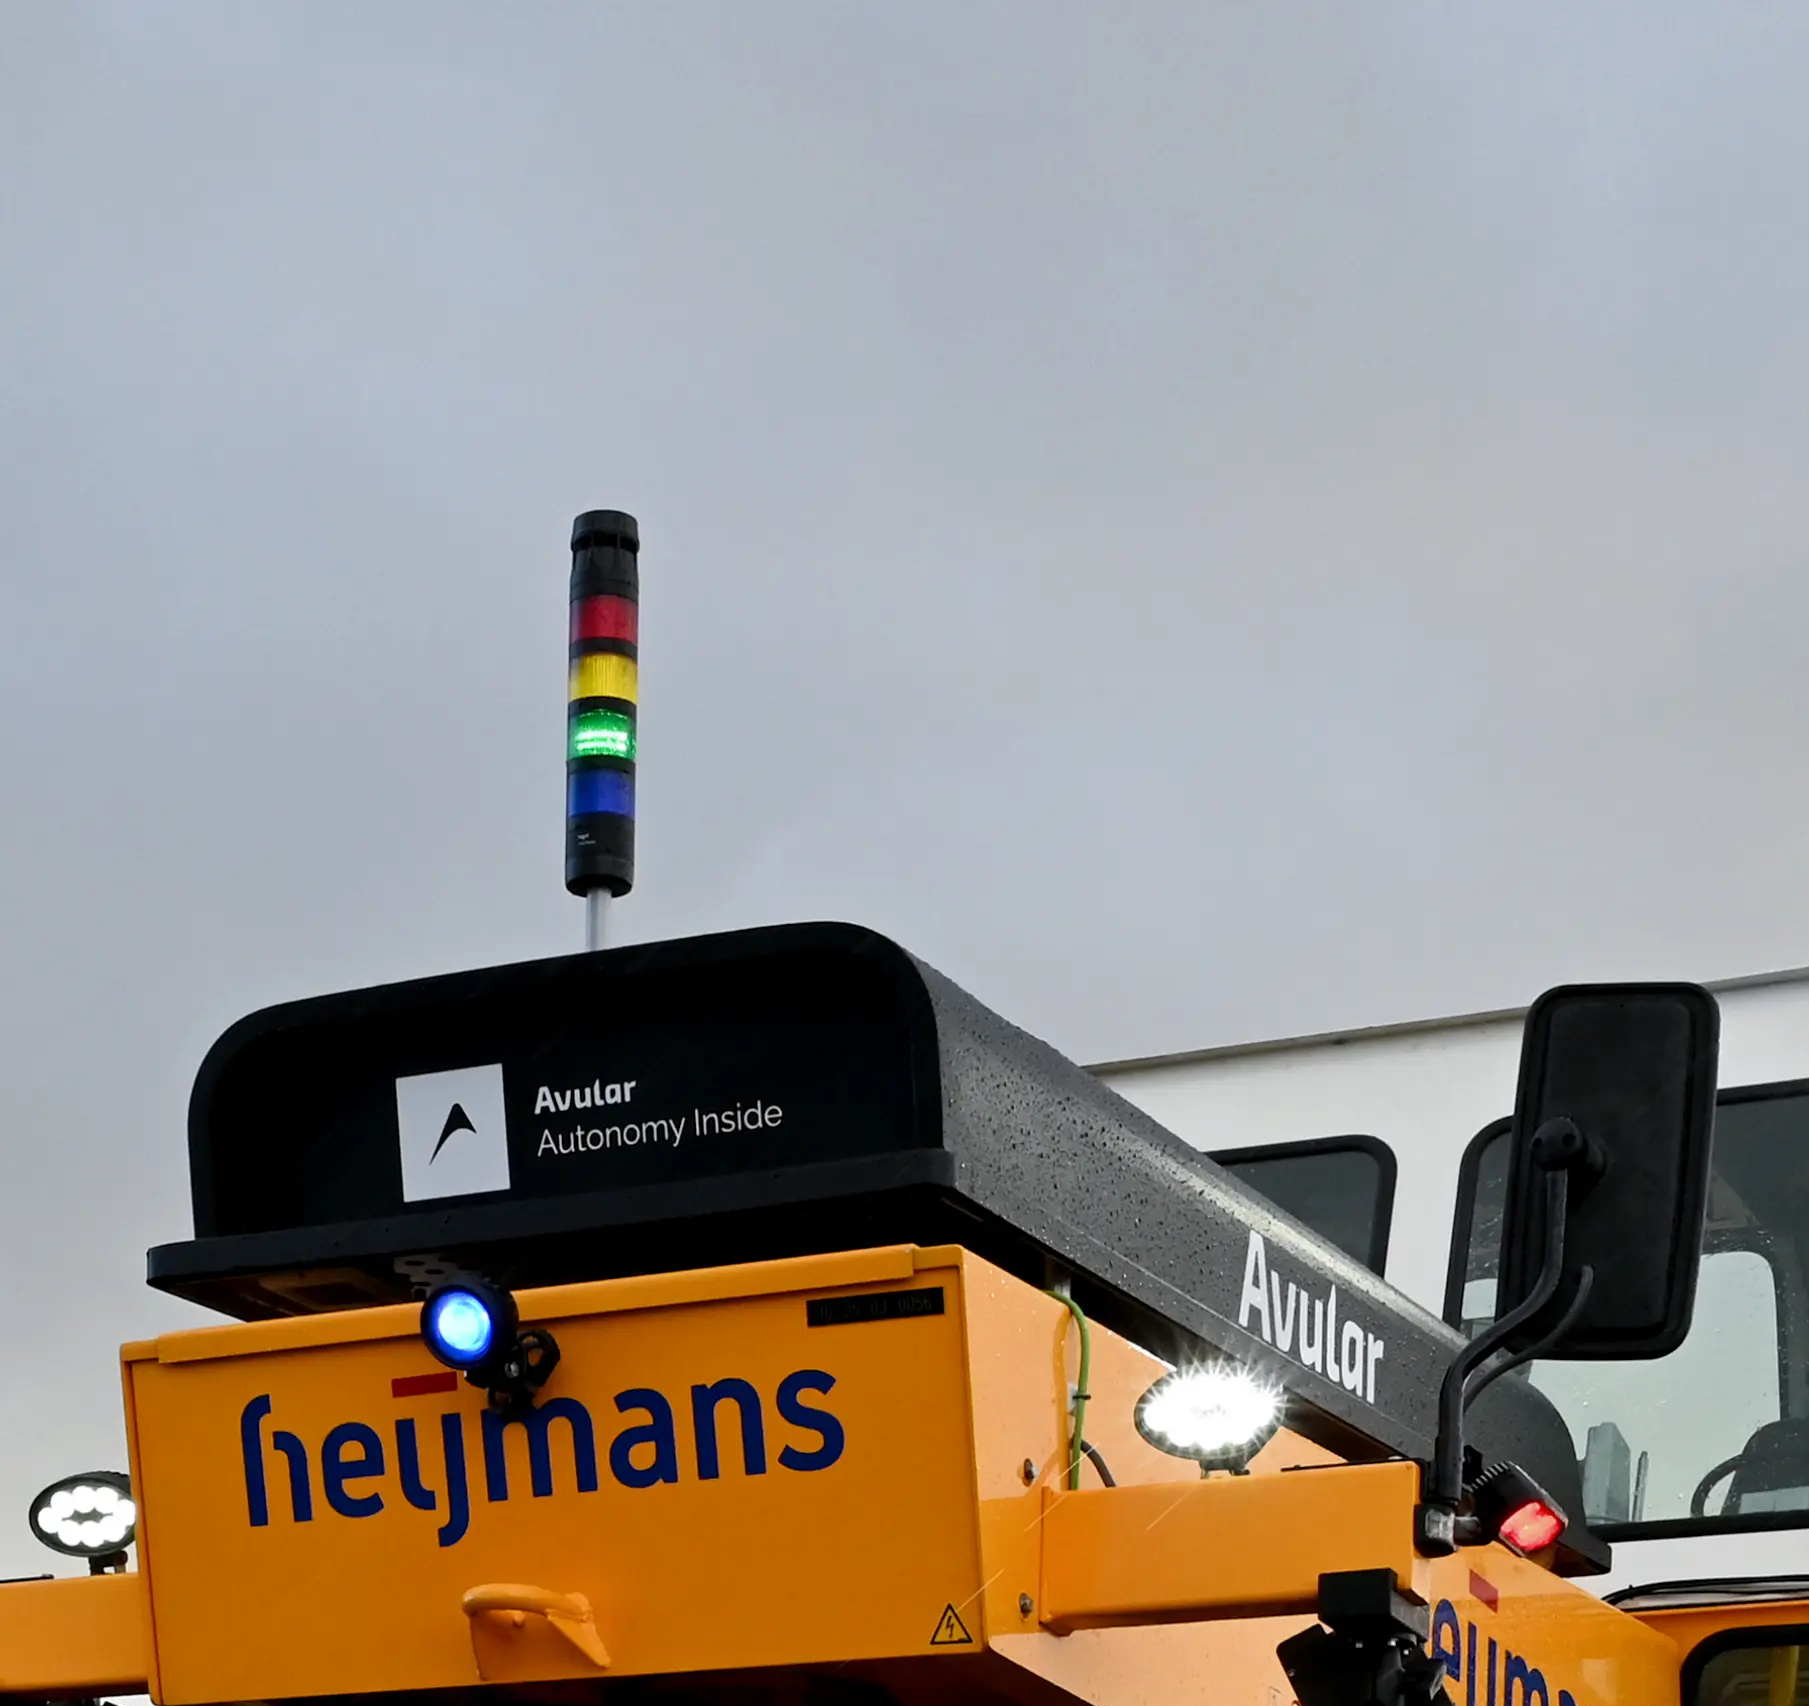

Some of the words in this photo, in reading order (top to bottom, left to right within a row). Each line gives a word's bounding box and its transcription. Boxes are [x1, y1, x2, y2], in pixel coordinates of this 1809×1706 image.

[534, 1078, 637, 1115] Avular
[537, 1116, 686, 1157] Autonomy
[694, 1099, 783, 1137] Inside
[1238, 1229, 1385, 1405] Avular
[240, 1368, 846, 1548] heijmans
